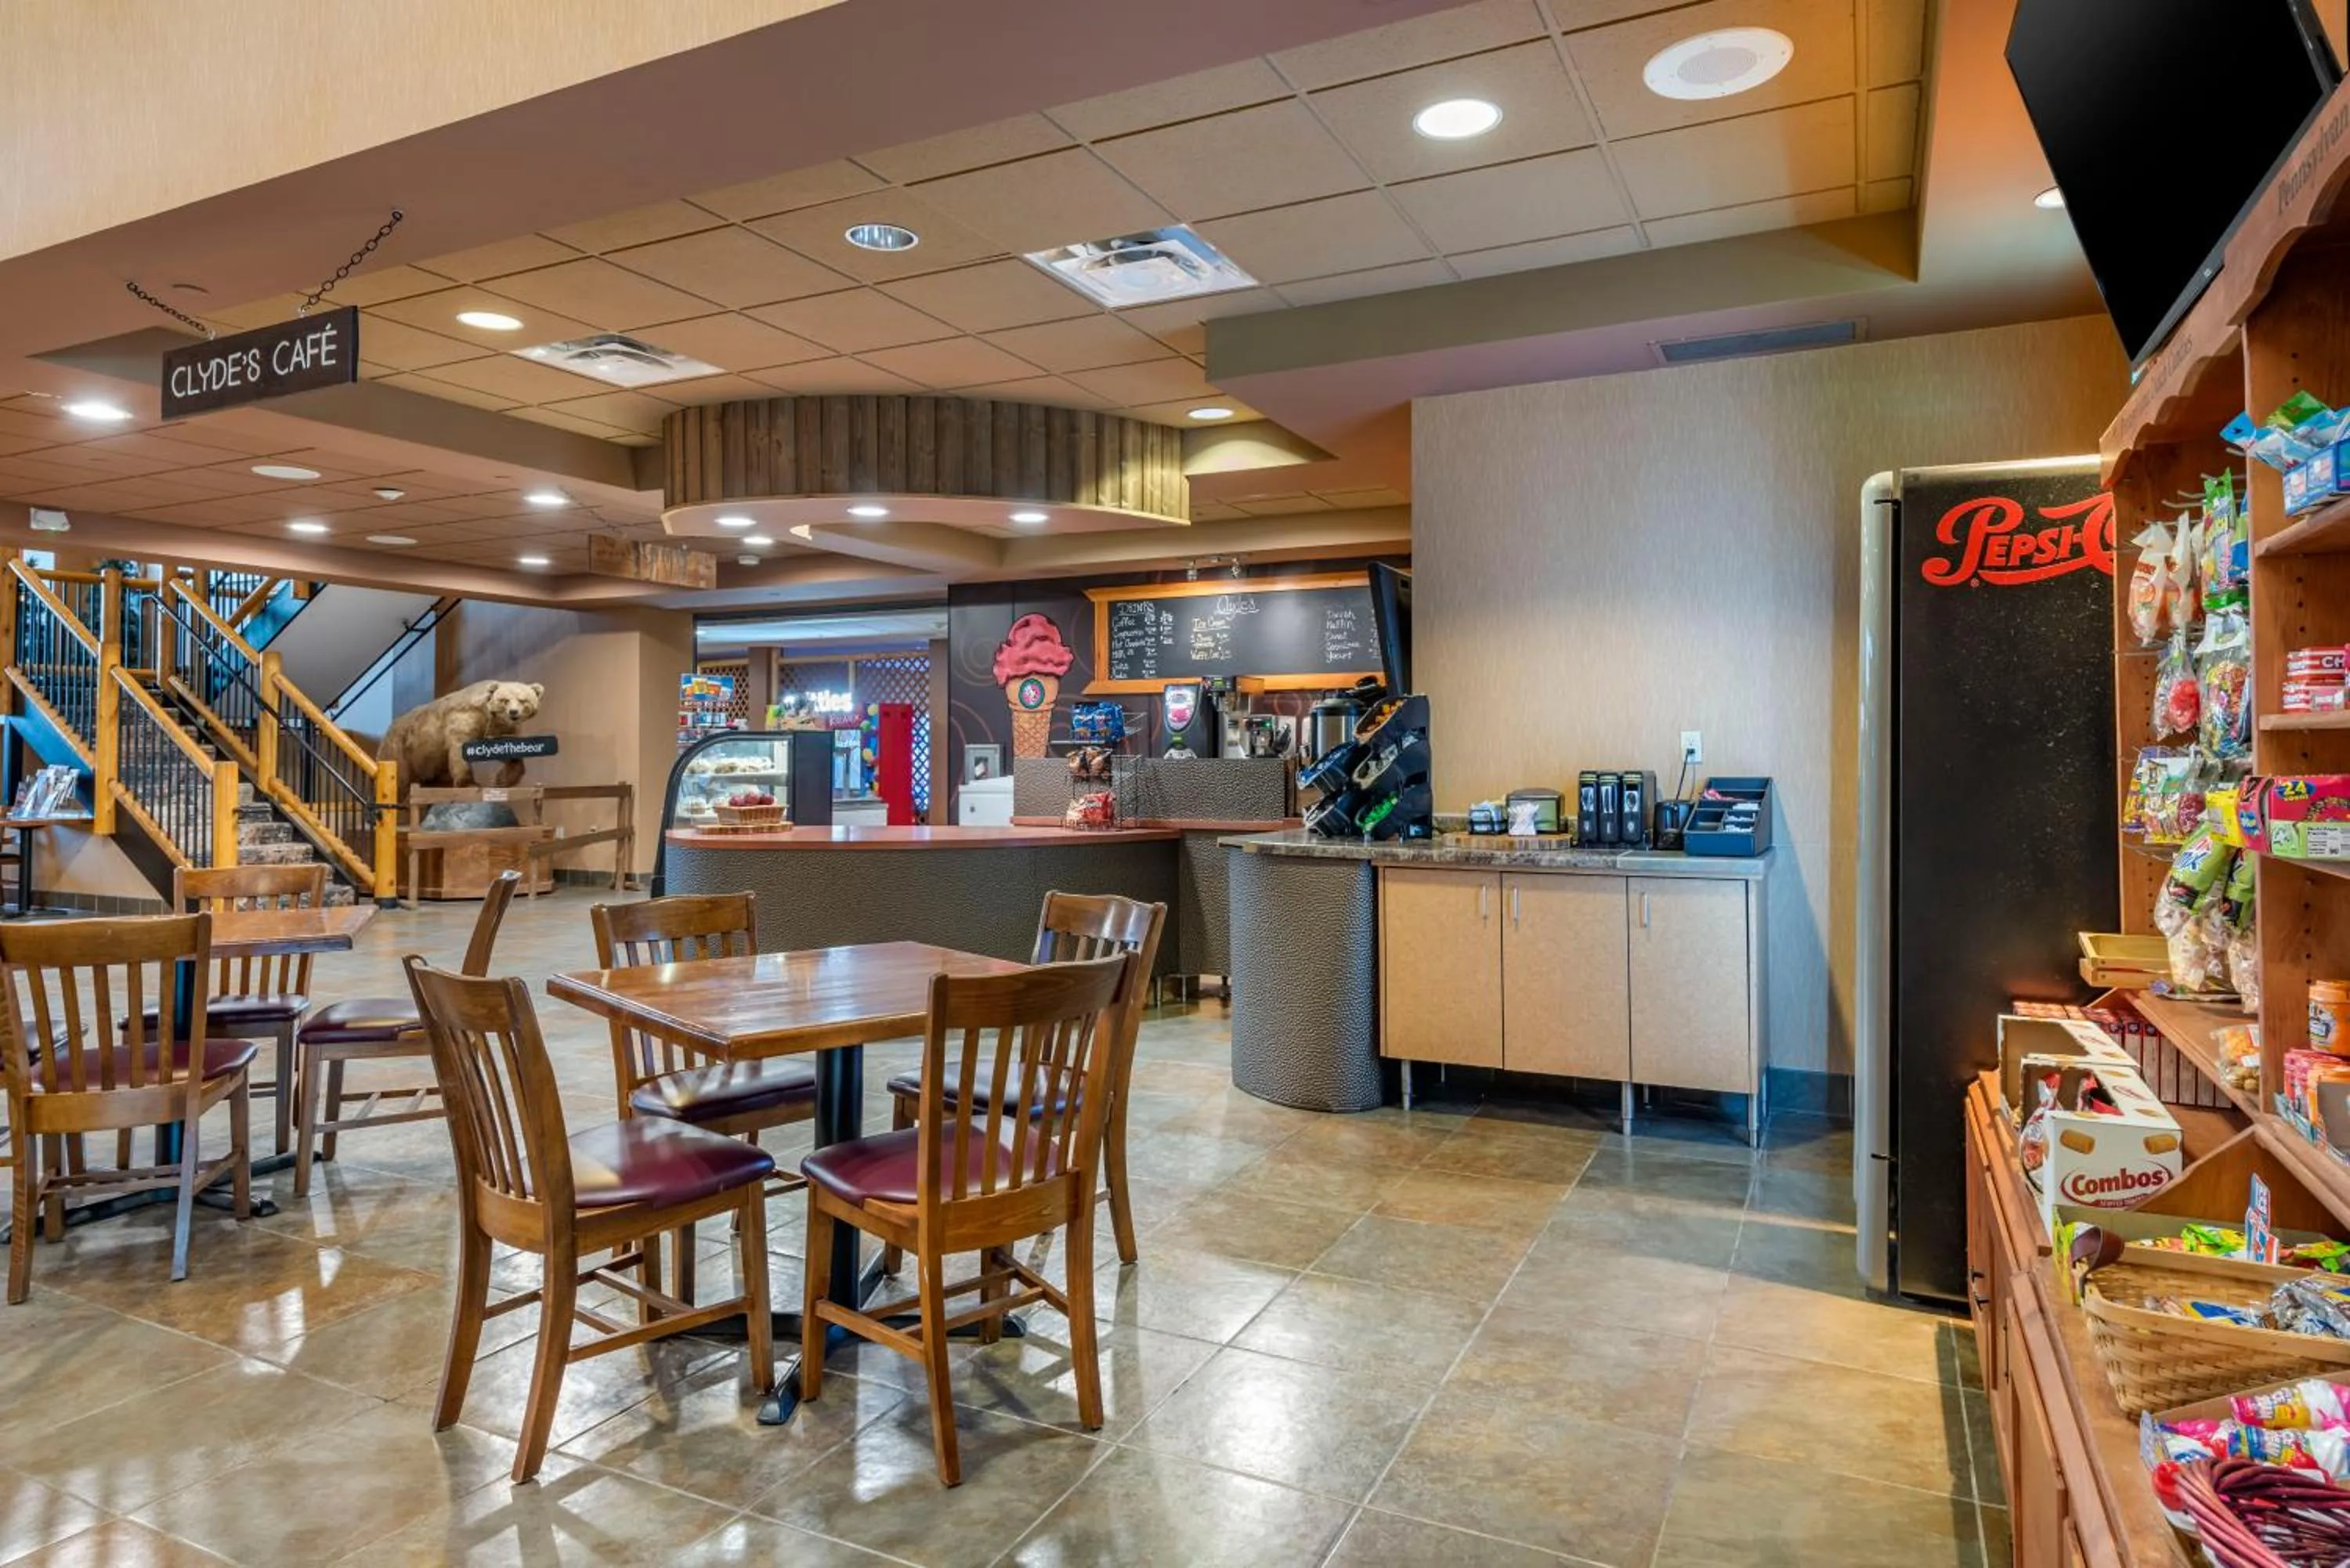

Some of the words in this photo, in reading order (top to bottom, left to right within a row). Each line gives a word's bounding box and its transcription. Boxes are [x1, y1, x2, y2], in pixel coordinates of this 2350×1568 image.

[172, 349, 261, 398] CLYDE'S
[273, 323, 338, 375] CAFÉ
[466, 741, 545, 757] #clydethebear
[2283, 780, 2308, 796] 24
[2071, 1168, 2164, 1196] Combos
